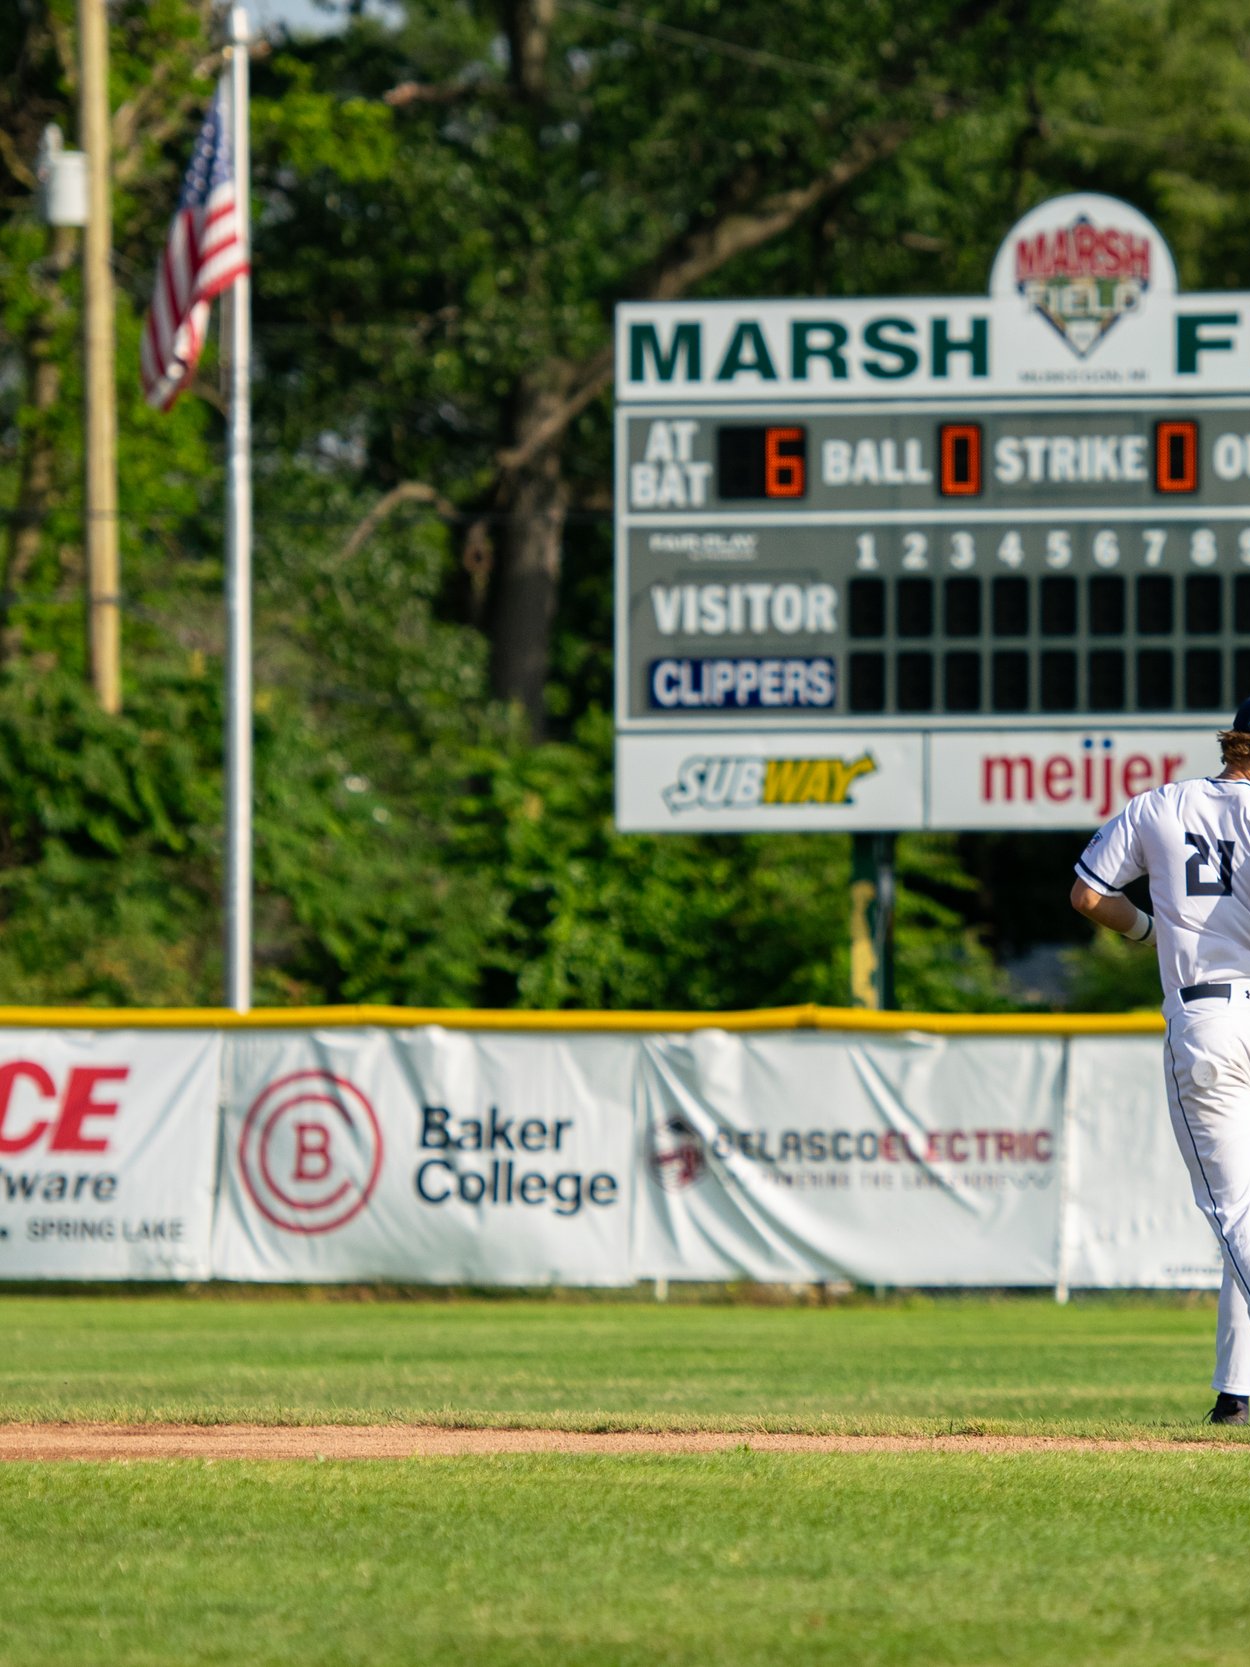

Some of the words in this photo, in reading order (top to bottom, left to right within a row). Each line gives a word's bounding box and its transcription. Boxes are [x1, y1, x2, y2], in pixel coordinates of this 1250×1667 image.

[1016, 223, 1150, 279] MARSH
[629, 318, 990, 382] MARSH
[645, 421, 698, 461] AT
[766, 427, 805, 496] 6
[822, 439, 932, 485] BALL
[941, 424, 981, 496] 0
[995, 435, 1149, 482] STRIKE
[1157, 421, 1197, 493] 0
[631, 464, 711, 508] BAT
[855, 535, 878, 570] 1
[903, 533, 928, 569] 2
[950, 533, 975, 568] 3
[999, 532, 1023, 567] 4
[1046, 531, 1071, 567] 5
[1093, 530, 1119, 567] 6
[1143, 529, 1168, 565] 7
[1190, 528, 1217, 565] 8
[652, 583, 838, 634] VISITOR
[653, 661, 835, 706] CLIPPERS
[664, 752, 877, 812] SUBWAY
[982, 734, 1184, 816] meijer
[1184, 832, 1235, 896] 21
[292, 1122, 333, 1182] B
[420, 1106, 572, 1153] Baker
[0, 1163, 118, 1202] ware
[415, 1158, 618, 1216] College
[28, 1216, 114, 1242] SPRING
[122, 1216, 185, 1242] LAKE
